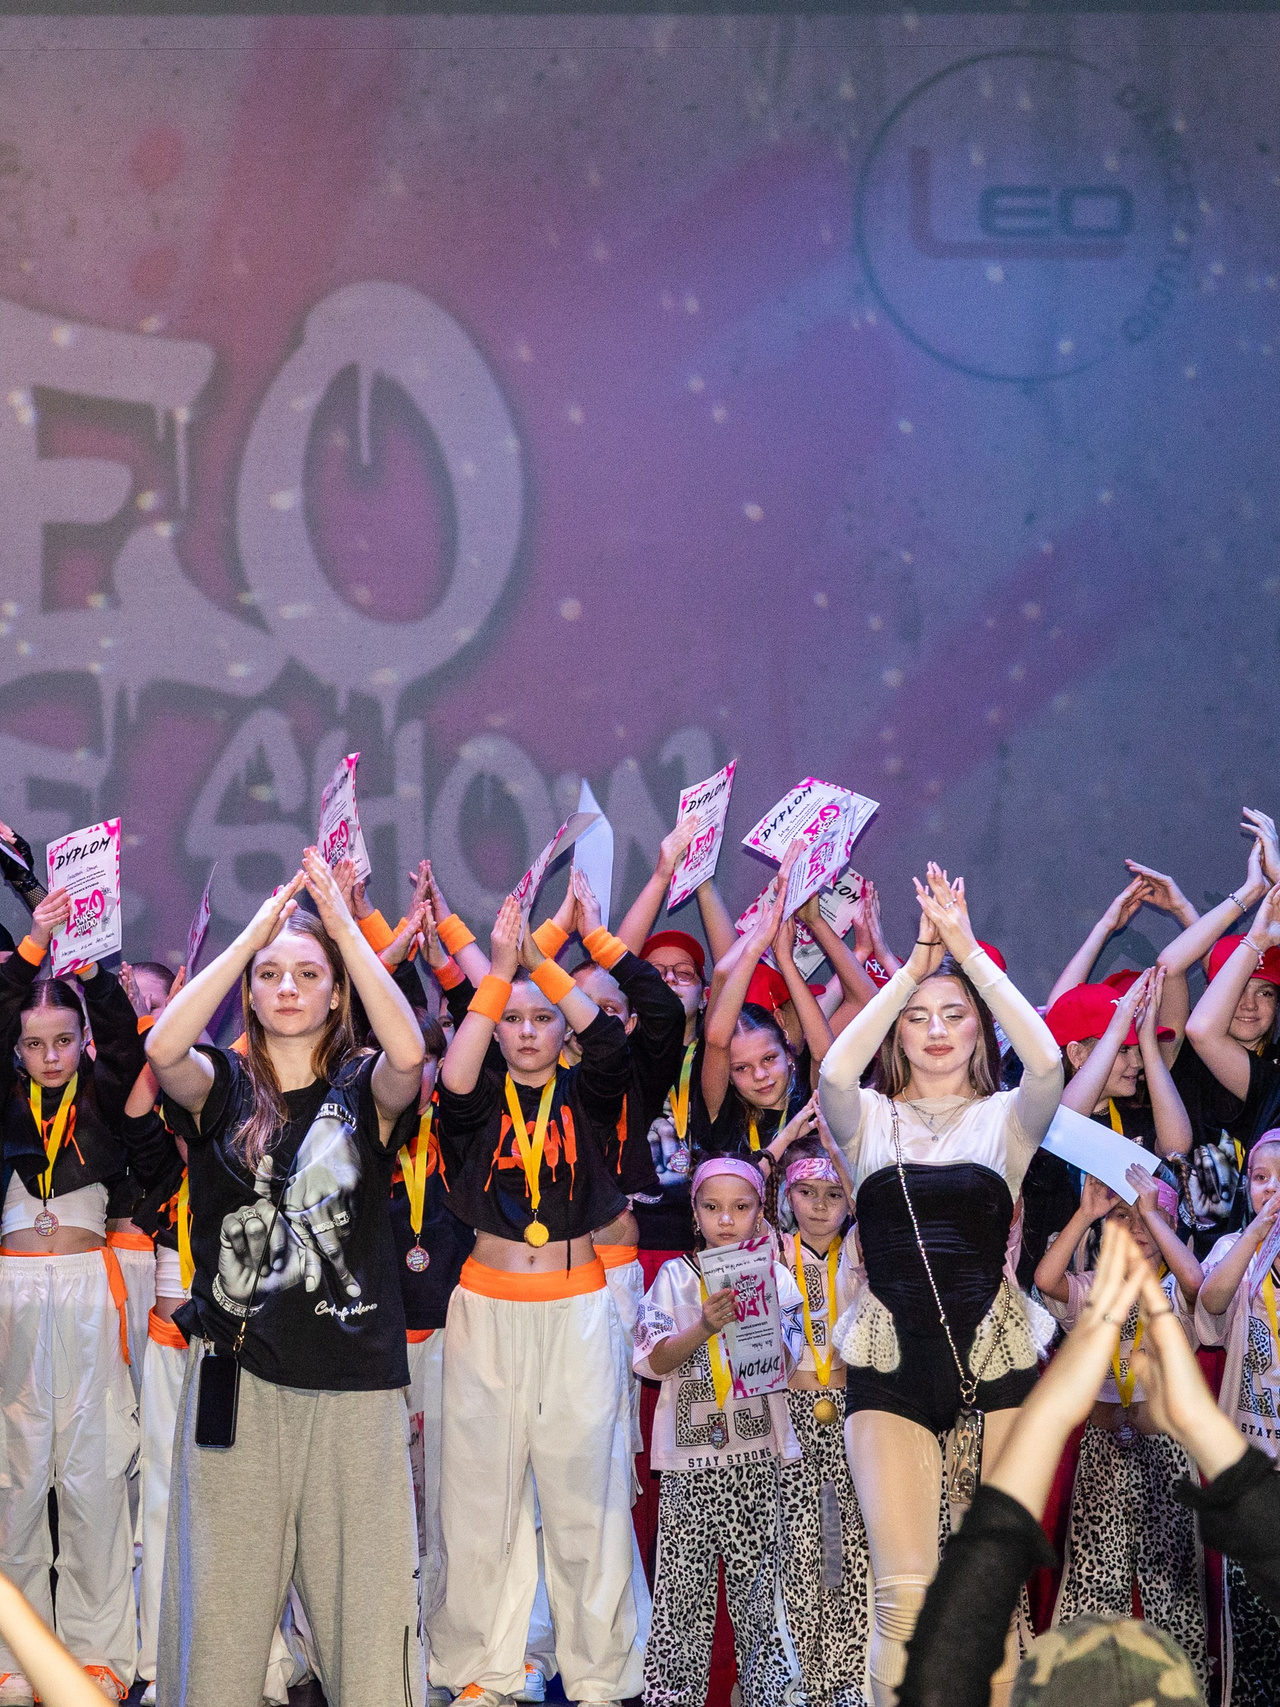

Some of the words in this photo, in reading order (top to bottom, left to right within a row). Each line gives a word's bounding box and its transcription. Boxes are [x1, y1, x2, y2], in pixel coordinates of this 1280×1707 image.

[909, 146, 1134, 259] LEO
[686, 778, 729, 814] DYPLOM
[761, 786, 813, 842] DYPLOM
[803, 804, 840, 838] EO
[54, 836, 111, 871] DYPLOM
[324, 820, 349, 864] LEO
[684, 826, 715, 871] LEO
[834, 880, 861, 904] LOM
[65, 889, 105, 935] LEO
[864, 958, 889, 980] NY
[739, 1355, 780, 1379] DYPLOM
[1241, 1423, 1272, 1439] STAY
[688, 1455, 719, 1468] STAY
[727, 1446, 772, 1465] STRONG
